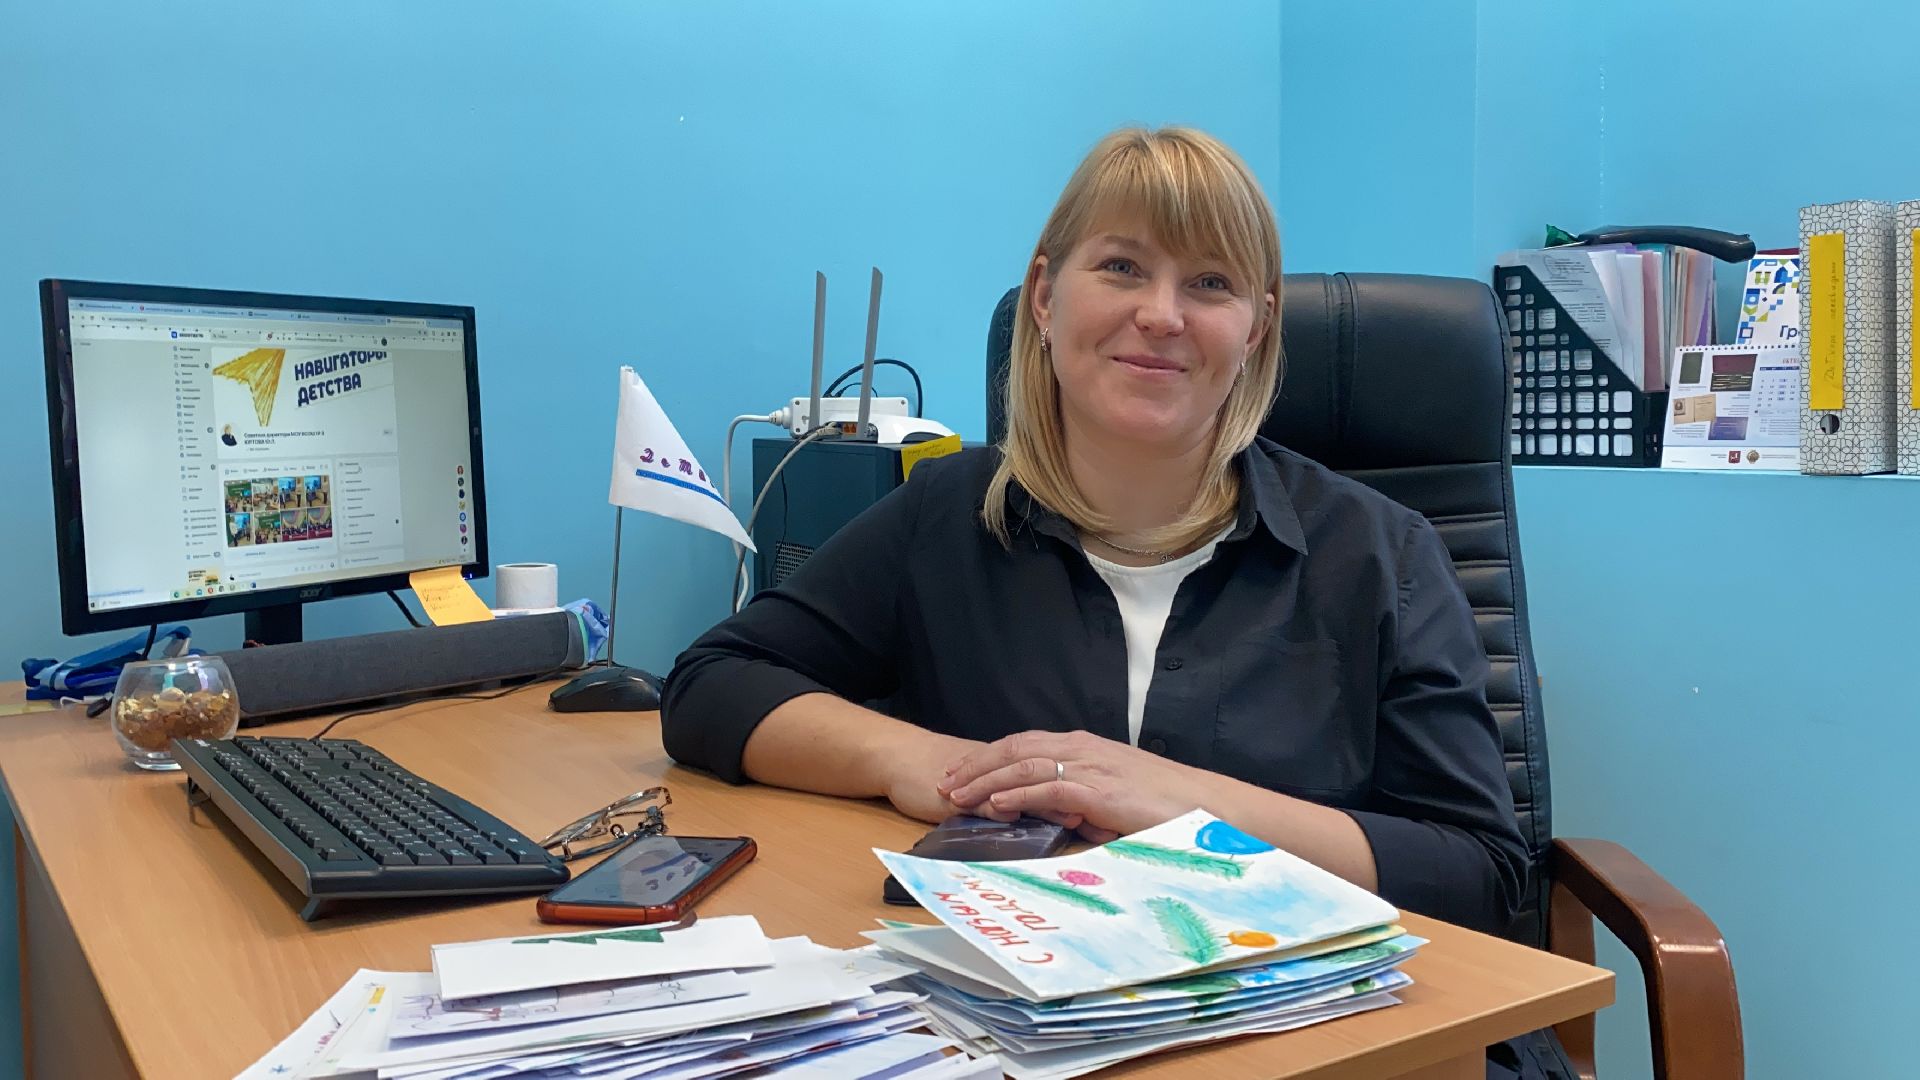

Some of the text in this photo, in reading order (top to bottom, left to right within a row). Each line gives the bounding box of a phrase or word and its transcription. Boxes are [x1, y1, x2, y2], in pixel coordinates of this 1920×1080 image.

[1779, 325, 1800, 341] Гр
[297, 372, 362, 408] ДЕТСТВА
[299, 587, 323, 598] acer
[1016, 951, 1053, 964] С
